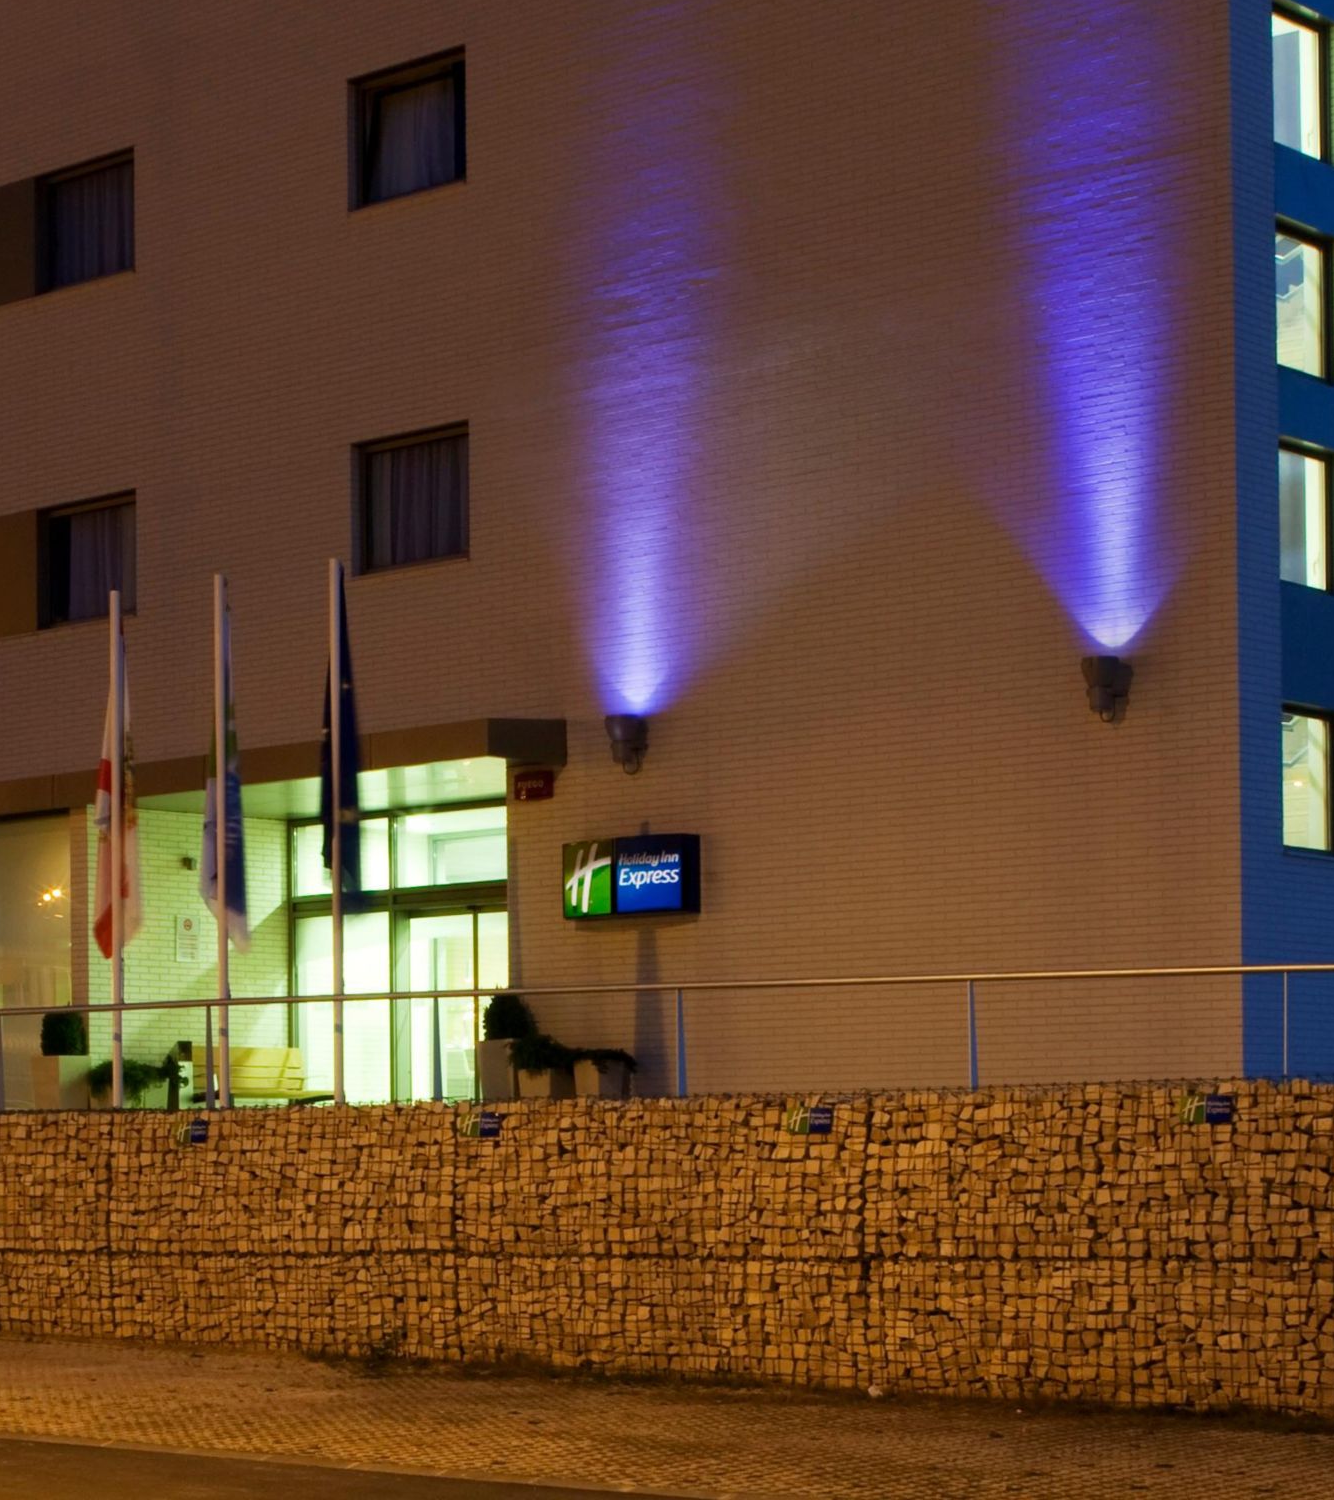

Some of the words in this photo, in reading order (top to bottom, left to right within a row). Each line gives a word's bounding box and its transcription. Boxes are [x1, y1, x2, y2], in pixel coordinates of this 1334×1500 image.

[619, 852, 659, 867] Holiday
[660, 850, 680, 863] Inn
[619, 868, 680, 889] Express
